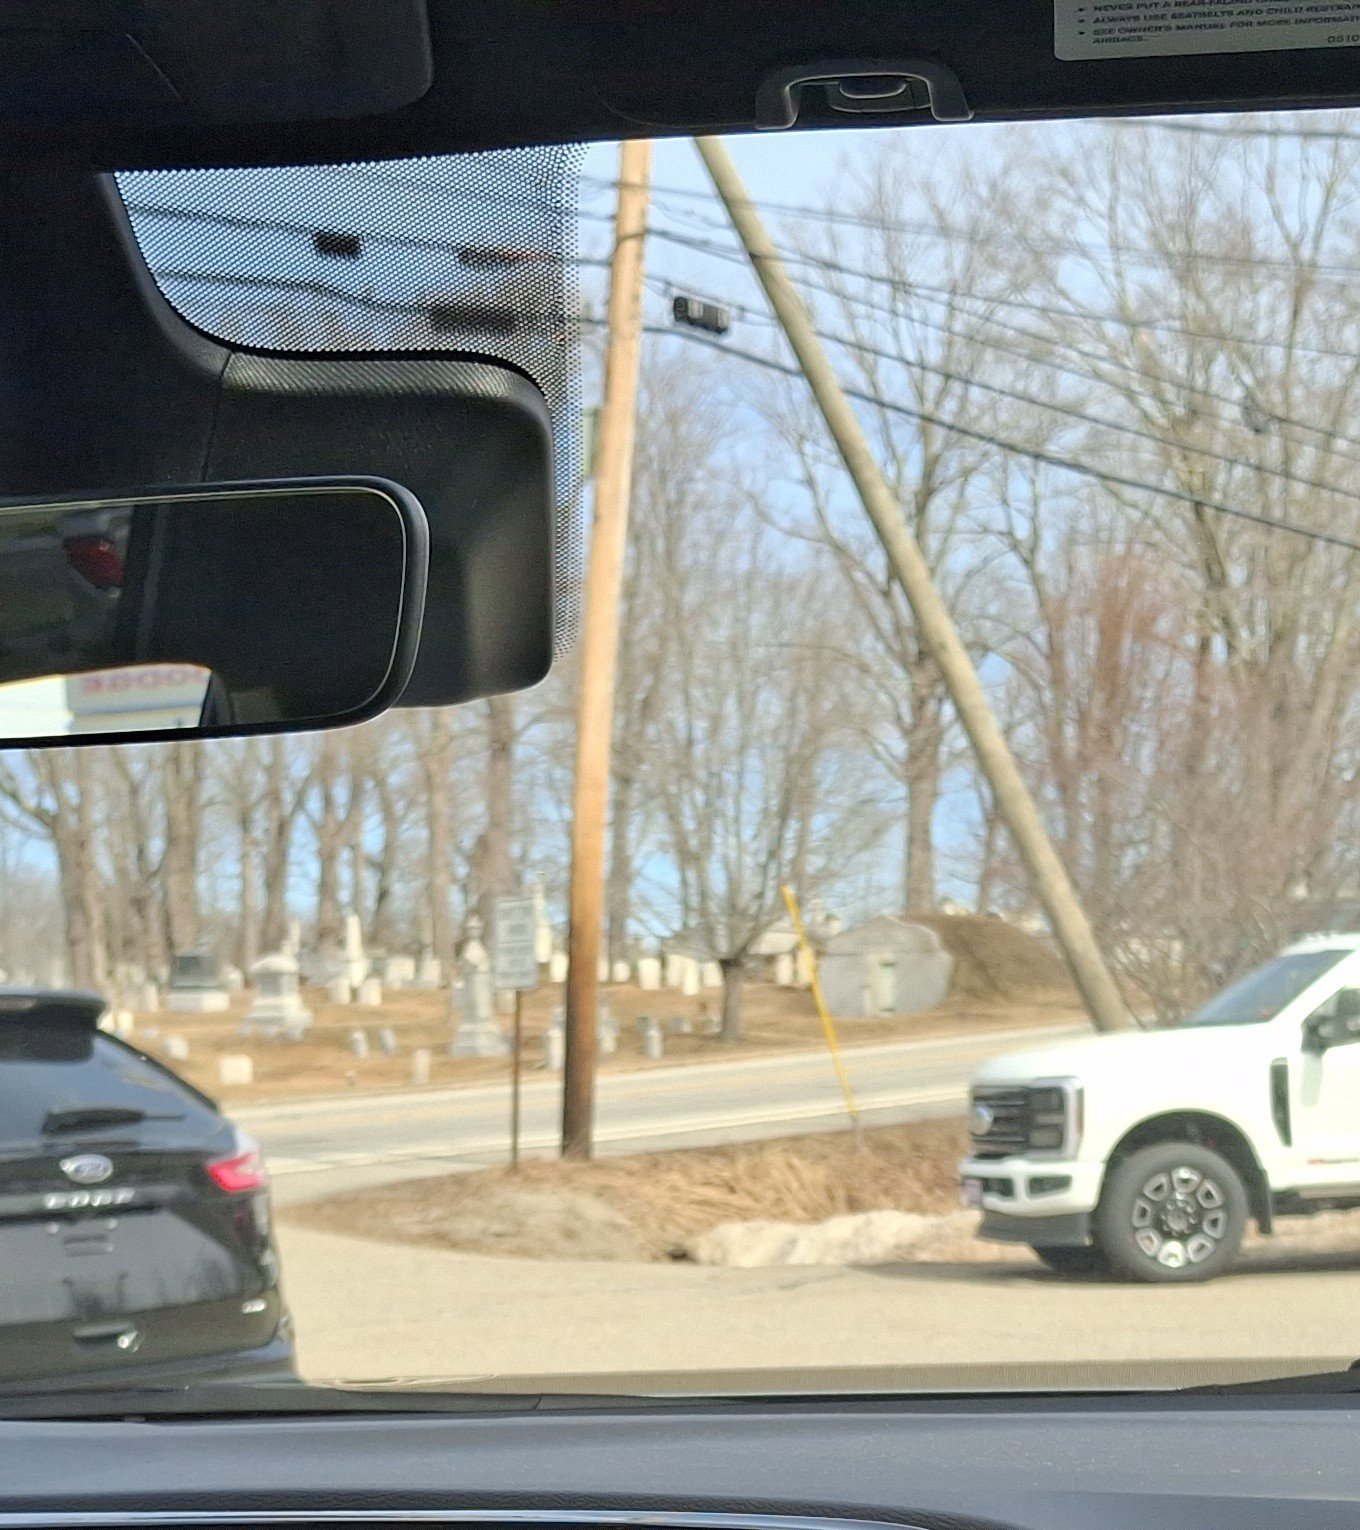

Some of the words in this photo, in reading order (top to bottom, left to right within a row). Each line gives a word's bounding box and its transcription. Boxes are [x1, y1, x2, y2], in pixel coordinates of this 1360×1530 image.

[1093, 15, 1141, 24] ALWAYS
[1176, 22, 1227, 31] MANUAL
[1230, 20, 1253, 29] FOR
